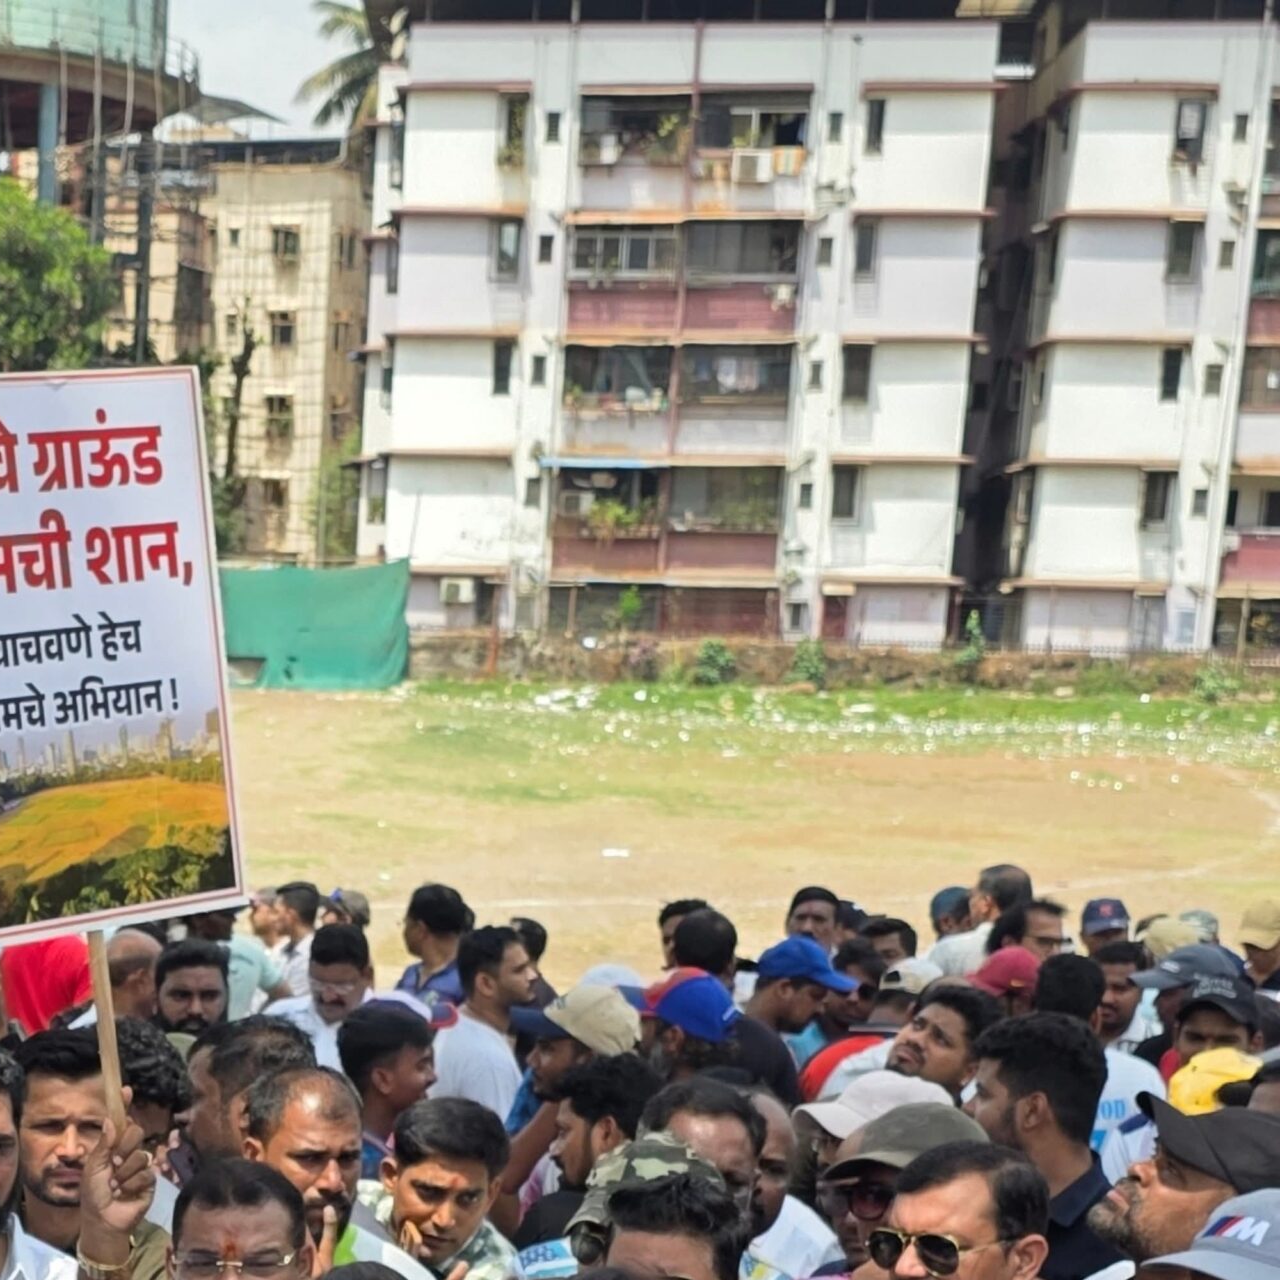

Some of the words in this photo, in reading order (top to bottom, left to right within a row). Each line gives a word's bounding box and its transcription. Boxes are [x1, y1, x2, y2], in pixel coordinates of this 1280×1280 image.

[27, 408, 163, 493] ग्राऊंड
[84, 520, 194, 587] शान,
[97, 611, 142, 661] हेच
